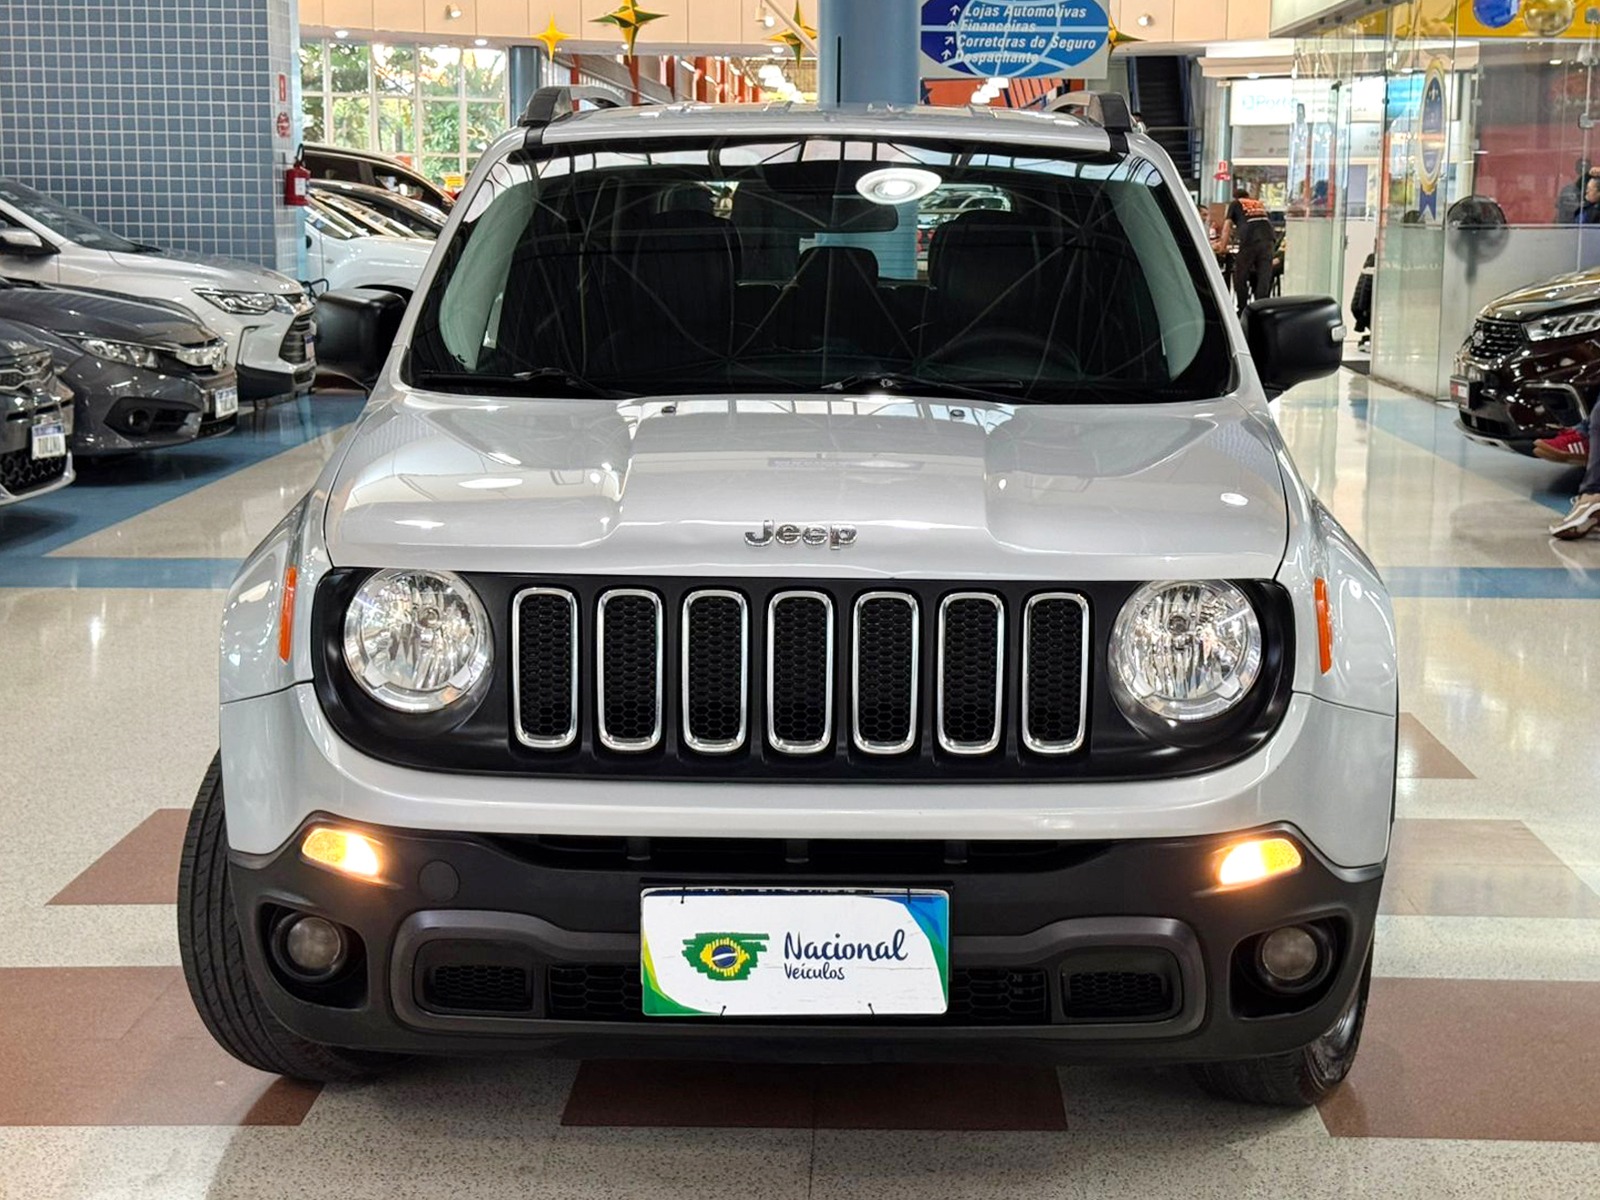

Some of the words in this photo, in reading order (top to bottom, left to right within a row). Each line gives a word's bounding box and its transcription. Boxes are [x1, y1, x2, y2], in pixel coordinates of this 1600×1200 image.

[965, 4, 1000, 19] Lojas
[1003, 5, 1087, 18] Automotivas
[960, 19, 1037, 32] Financeiras
[958, 34, 1026, 48] Corretoras
[1030, 35, 1046, 48] de
[1051, 35, 1097, 52] Seguro
[955, 49, 1040, 65] Despachante
[744, 520, 858, 551] Jeep
[784, 929, 908, 961] Nacional
[784, 962, 845, 981] Veículos
